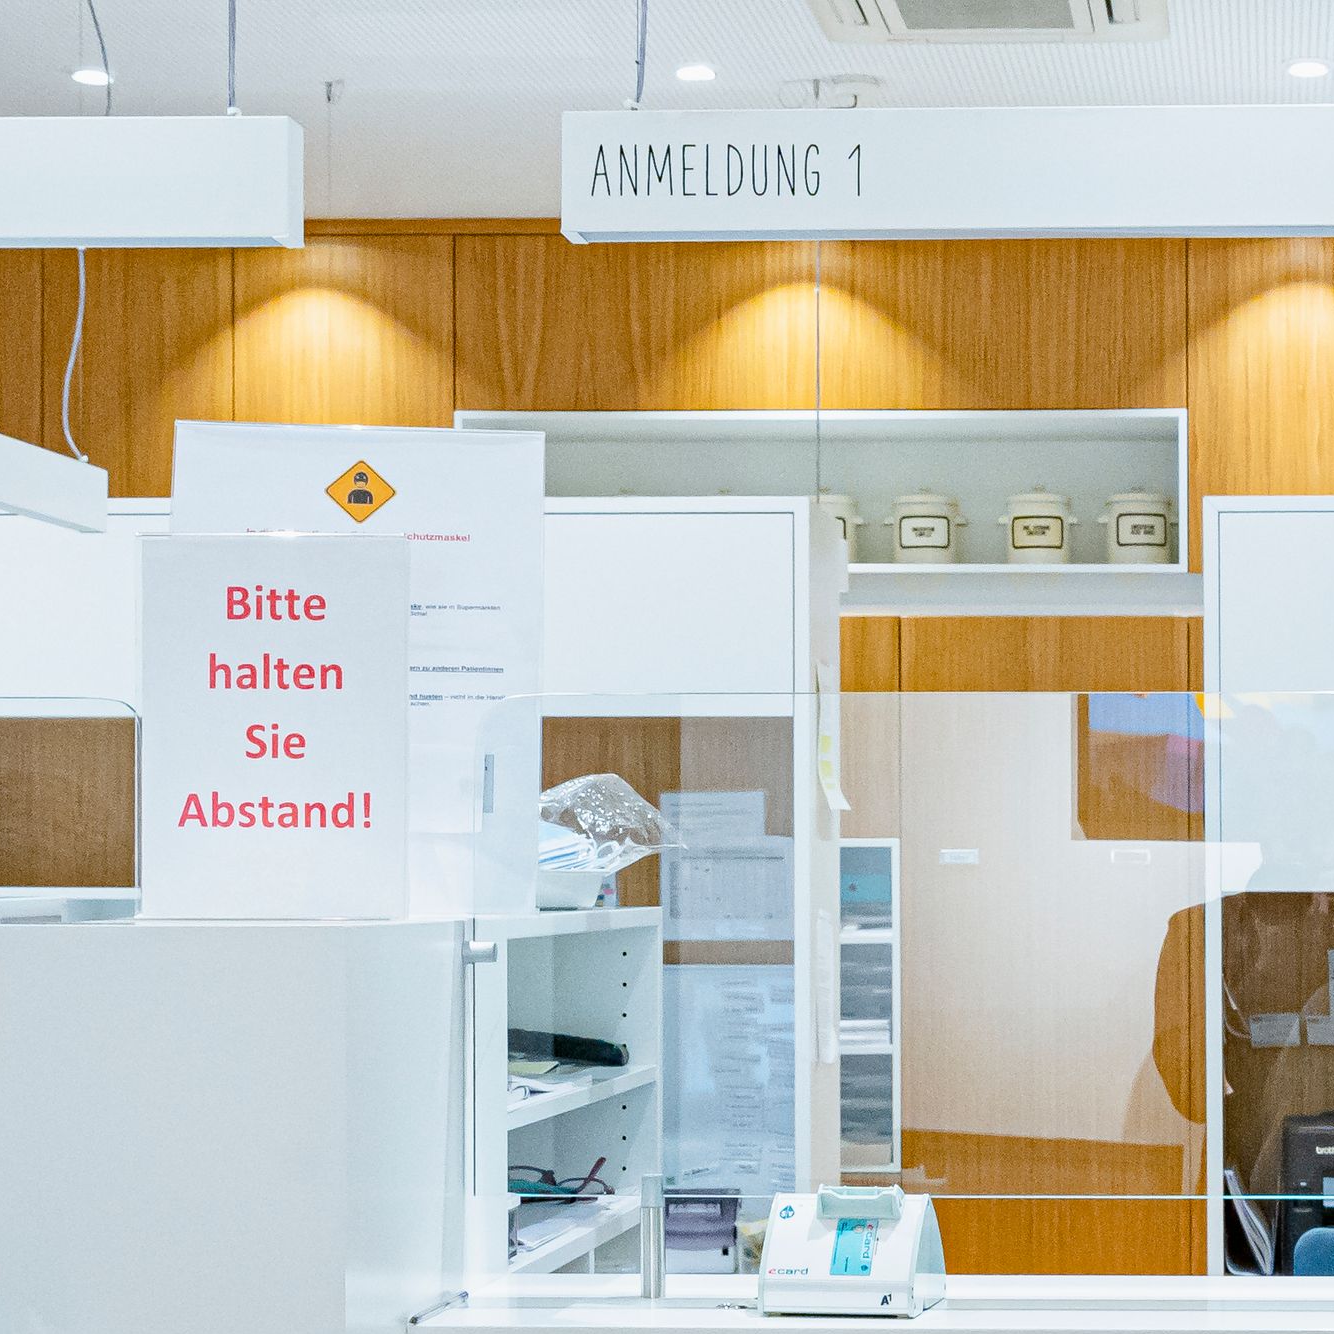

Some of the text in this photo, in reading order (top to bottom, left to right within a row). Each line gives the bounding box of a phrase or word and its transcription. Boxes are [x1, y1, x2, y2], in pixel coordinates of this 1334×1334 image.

[590, 143, 862, 197] ANMELDUNG 1
[226, 584, 327, 622] Bitte
[208, 652, 344, 691] halten
[245, 722, 307, 760] Sie
[178, 790, 372, 829] Abstand!
[768, 1267, 809, 1276] ecard
